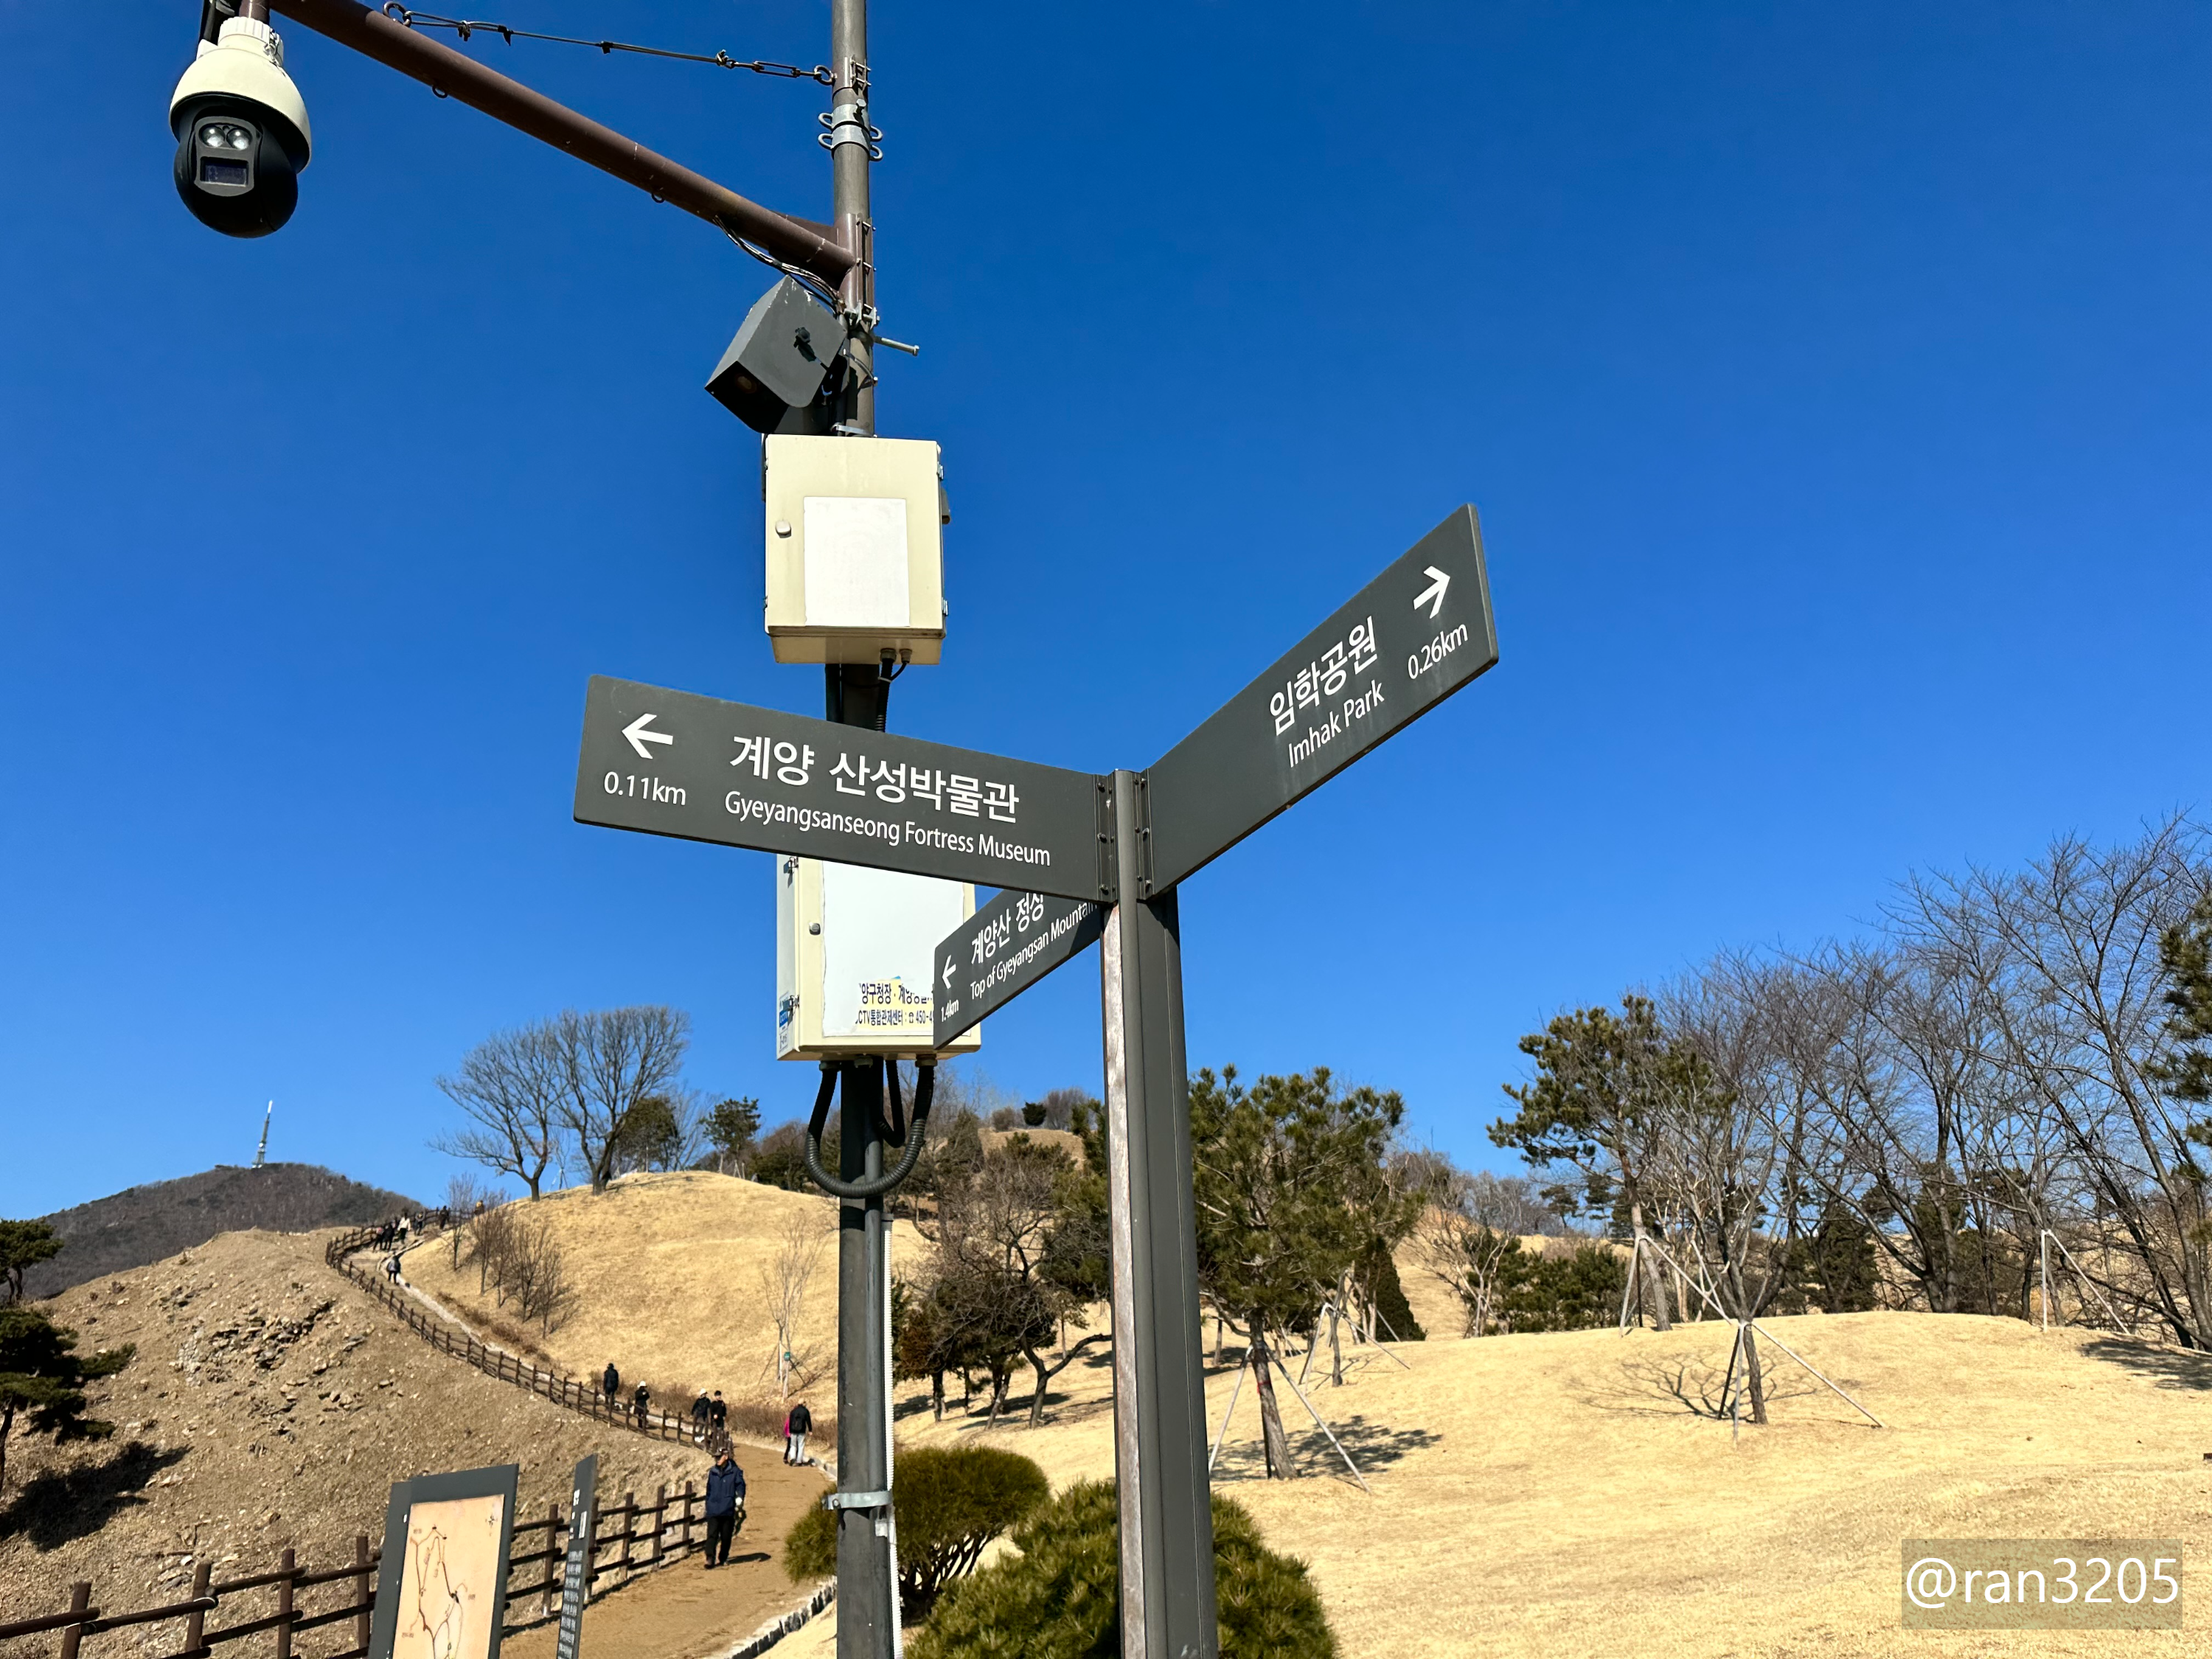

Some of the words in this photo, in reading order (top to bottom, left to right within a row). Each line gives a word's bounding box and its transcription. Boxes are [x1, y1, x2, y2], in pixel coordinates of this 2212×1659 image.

[1270, 616, 1377, 736] 임학공원
[1408, 624, 1469, 680] 0.26km
[1287, 711, 1341, 768] Imhak
[1344, 681, 1385, 727] Park
[604, 771, 686, 806] 0.11km
[730, 737, 814, 786] 계양
[829, 753, 1020, 824] 산성박물관
[725, 790, 900, 846] Gyeyangsanseong
[905, 821, 974, 853] Fortress
[978, 833, 1051, 866] Museum
[971, 908, 1012, 964] 계양산
[858, 982, 892, 1005] 양구청장
[970, 981, 986, 1000] Top
[987, 967, 995, 988] of
[996, 932, 1049, 983] Gyeyangsan
[855, 1009, 903, 1026] CTV통합관제센터
[941, 999, 959, 1023] 1.4km
